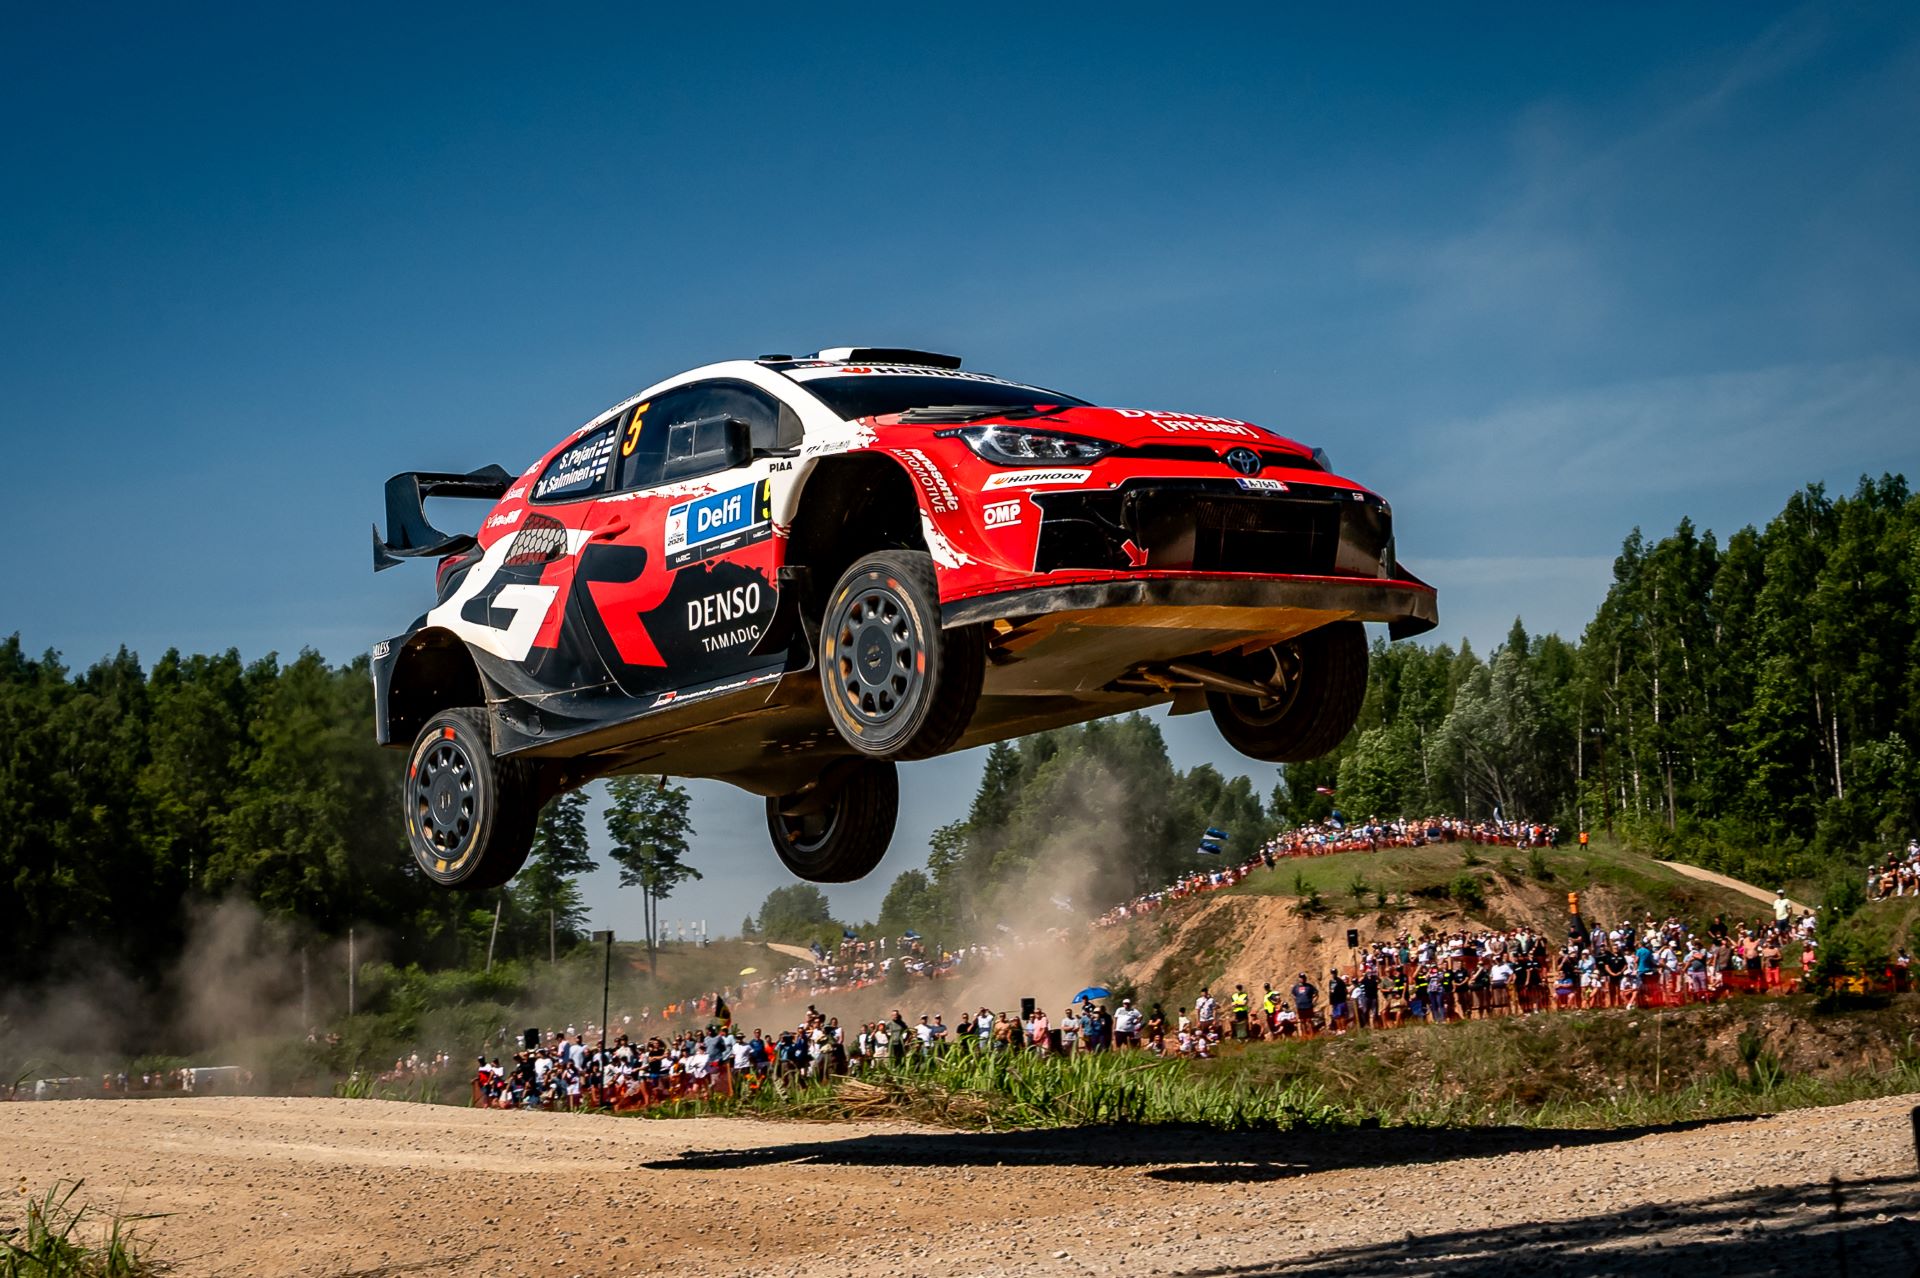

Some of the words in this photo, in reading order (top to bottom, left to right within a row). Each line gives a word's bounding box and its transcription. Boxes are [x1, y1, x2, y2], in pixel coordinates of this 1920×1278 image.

[622, 402, 651, 457] 5
[769, 461, 793, 473] PIAA
[889, 448, 946, 514] AUTOMOTIVE
[905, 448, 959, 512] Panasonic
[1248, 479, 1279, 489] A-7647
[697, 494, 742, 533] Delfi
[984, 504, 1021, 524] OMP
[687, 582, 761, 632] DENSO
[701, 624, 760, 653] TAMADIC
